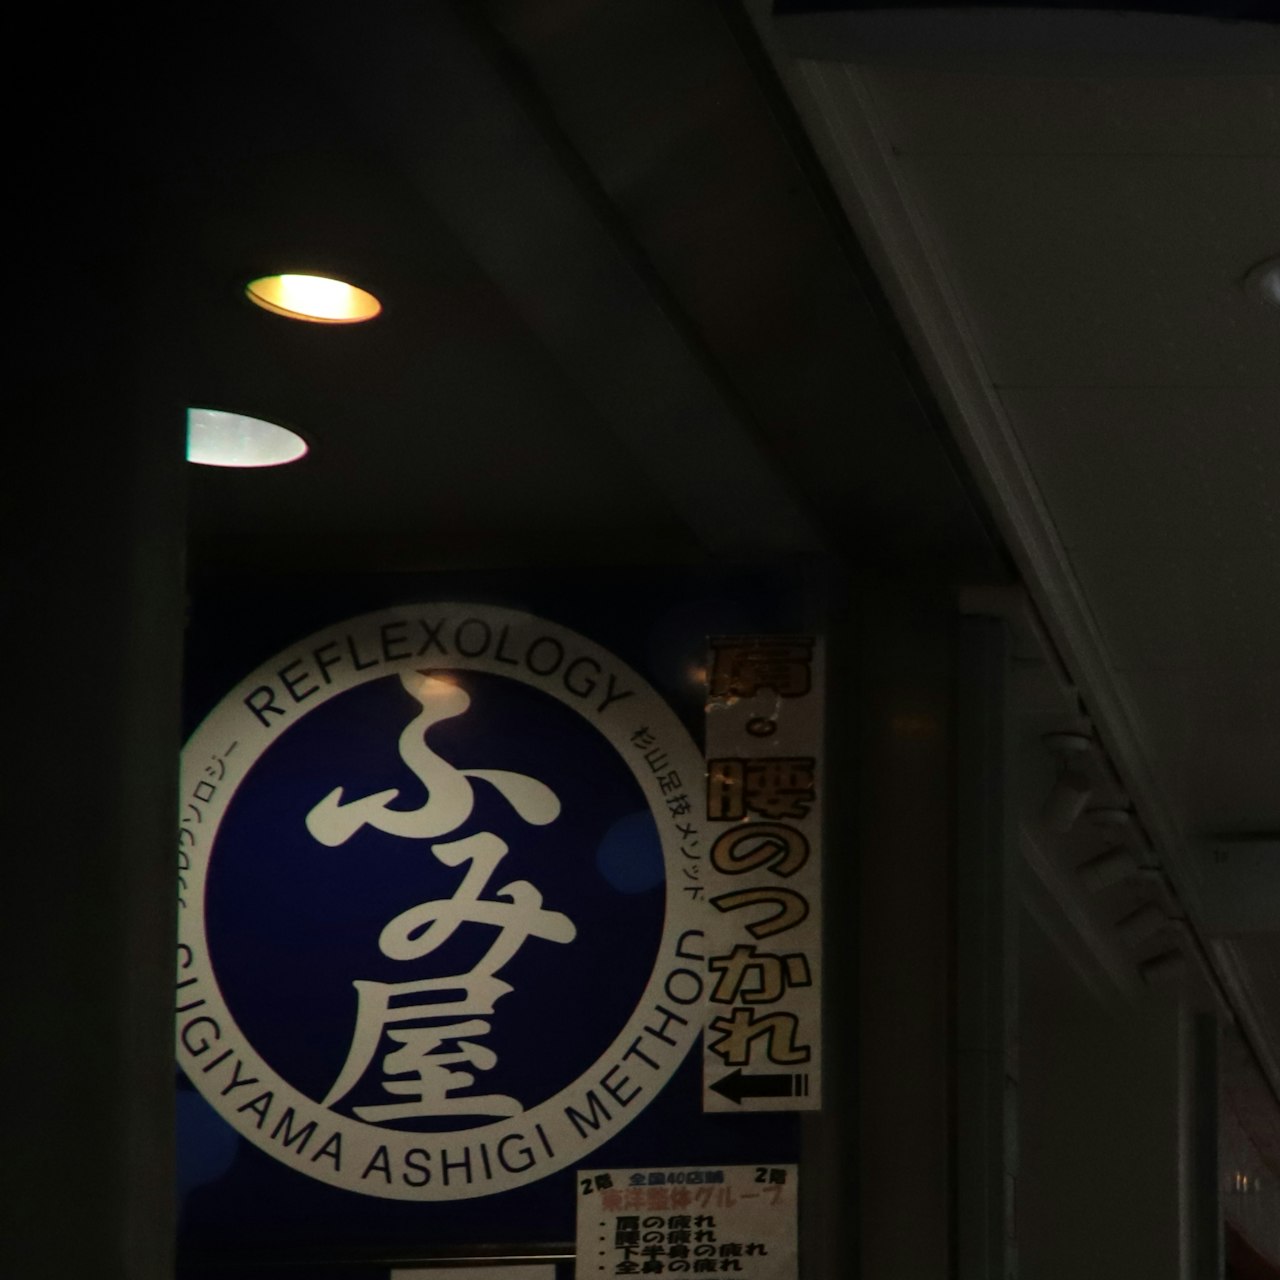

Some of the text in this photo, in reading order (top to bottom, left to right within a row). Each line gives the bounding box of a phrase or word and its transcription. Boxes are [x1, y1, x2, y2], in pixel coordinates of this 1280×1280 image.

[244, 615, 634, 729] REFLEXOLOGY
[304, 671, 578, 1125] ふみ屋
[362, 1121, 555, 1188] ASHIGI
[572, 927, 704, 1136] METHOD
[581, 1173, 613, 1195] 2階
[754, 1168, 787, 1185] 2階
[615, 1243, 768, 1260] 下半身の疲れ
[615, 1259, 743, 1275] 全身の疲れ
